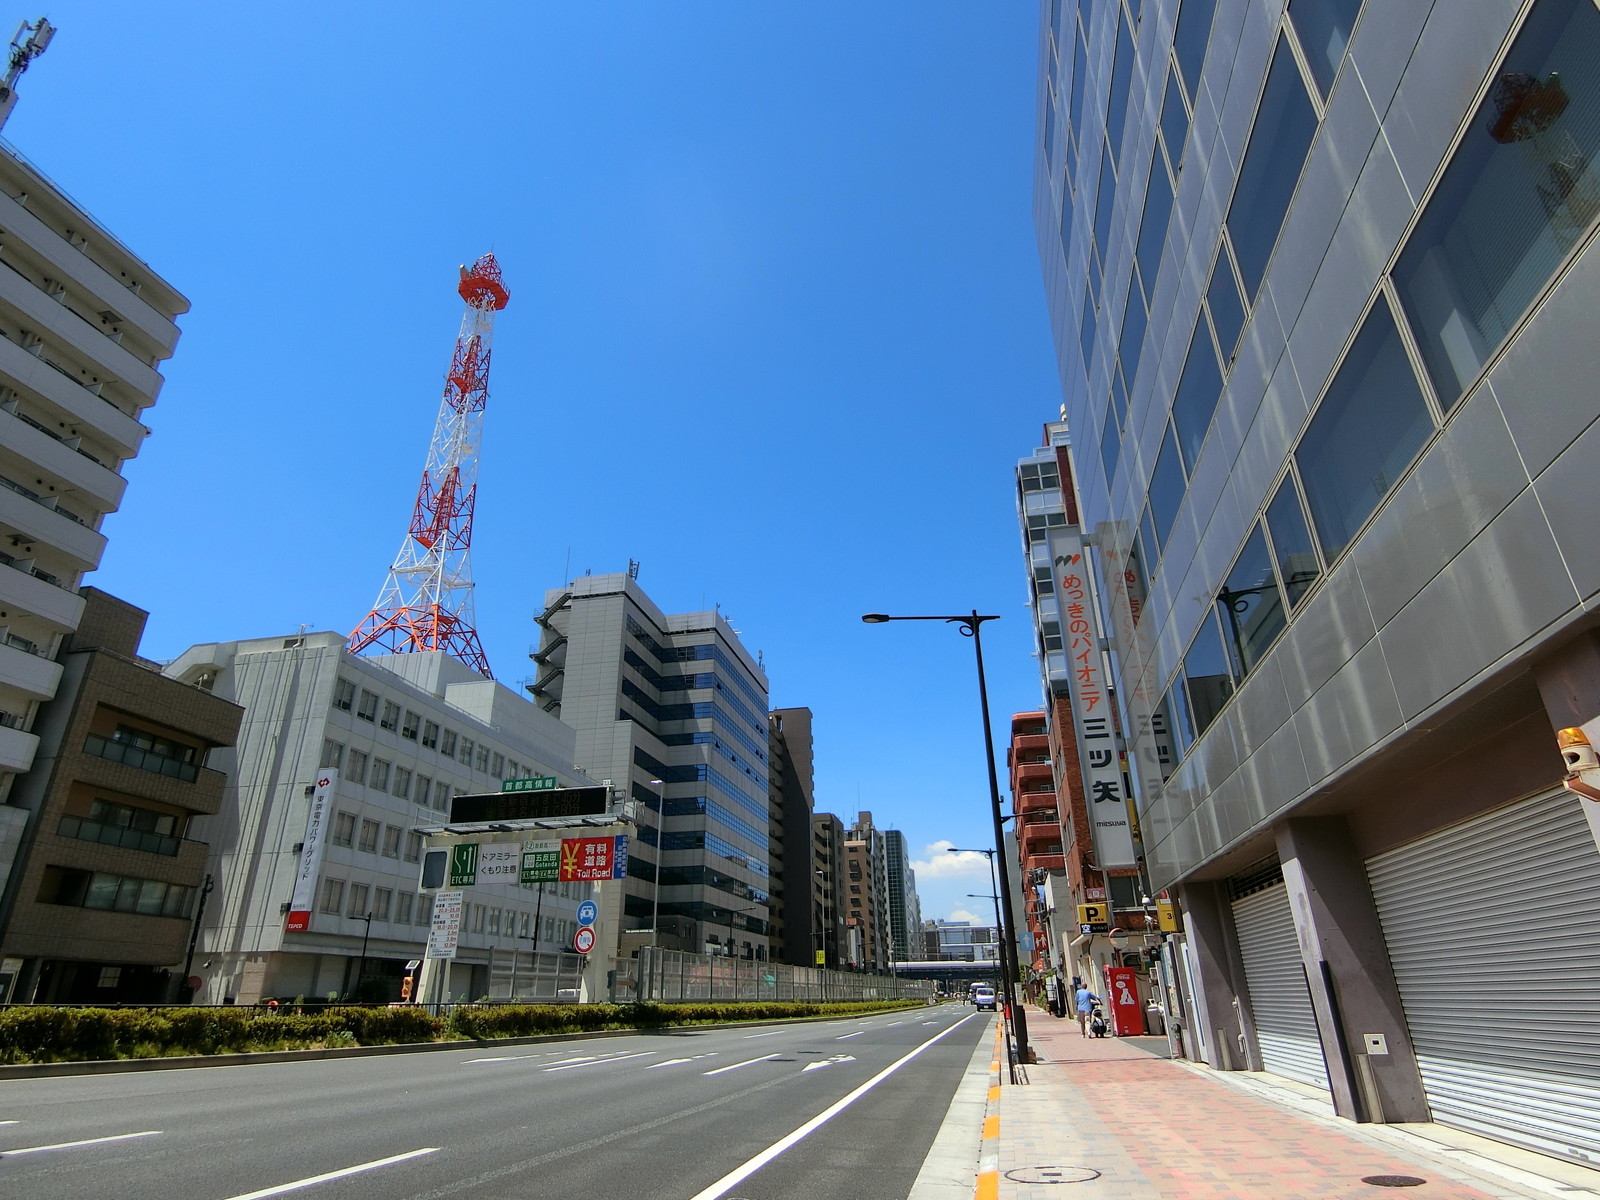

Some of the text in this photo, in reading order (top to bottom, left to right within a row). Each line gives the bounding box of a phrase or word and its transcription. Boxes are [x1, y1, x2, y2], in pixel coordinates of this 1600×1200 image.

[1063, 574, 1101, 712] めっきのパイオニア
[505, 779, 553, 791] 首都高情報
[1096, 819, 1127, 828] mitsuya
[585, 842, 607, 855] 有料
[482, 853, 518, 862] ドアミラー
[536, 853, 557, 862] 五反田
[584, 855, 607, 867] 道路
[481, 864, 517, 875] くもり注意
[577, 867, 611, 878] Toll Road
[451, 875, 475, 884] ETC専用
[1085, 907, 1099, 922] P
[1166, 912, 1173, 920] 3
